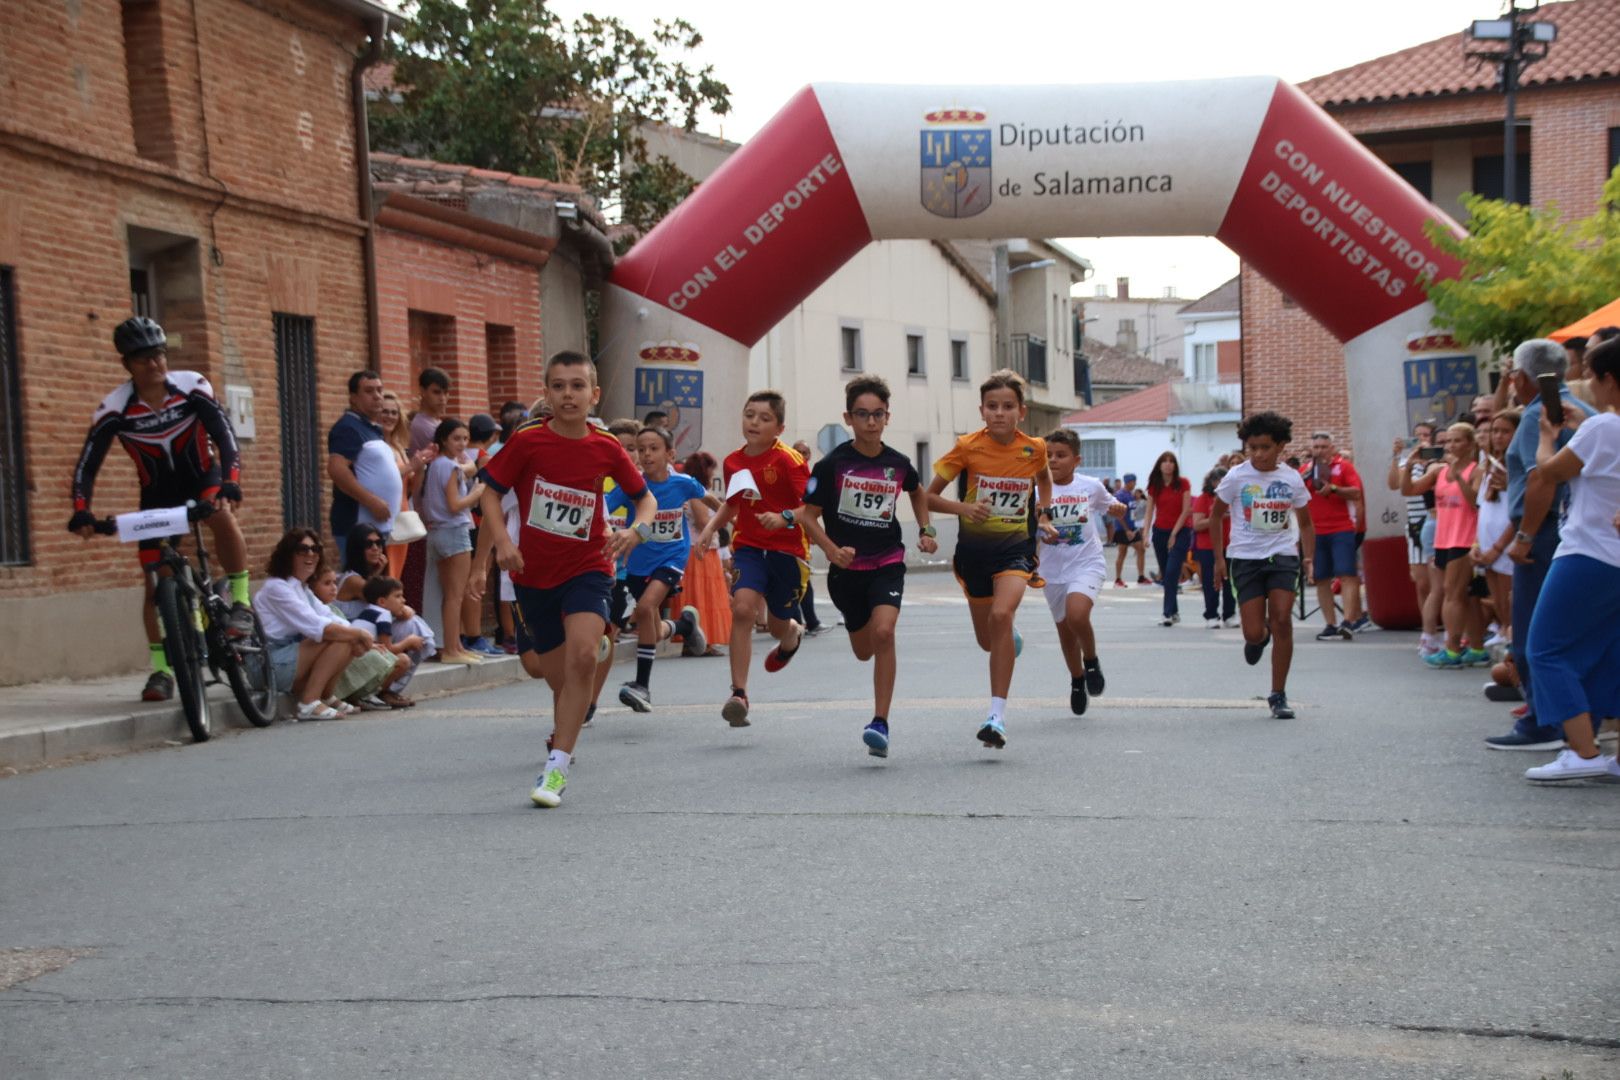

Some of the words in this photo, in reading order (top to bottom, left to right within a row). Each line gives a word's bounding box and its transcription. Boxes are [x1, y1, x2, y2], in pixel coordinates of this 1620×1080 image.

[999, 118, 1145, 151] Diputación
[998, 177, 1022, 197] de
[1033, 170, 1172, 196] Salamanca
[1274, 139, 1325, 187] CON
[1321, 179, 1440, 281] NUESTROS
[667, 265, 718, 311] CON
[713, 243, 748, 272] EL
[743, 153, 843, 245] DEPORTE
[1259, 170, 1406, 298] DEPORTISTAS
[844, 478, 896, 494] bedunia
[980, 479, 1029, 491] bedunia
[853, 492, 884, 510] 159
[989, 491, 1020, 508] 172
[544, 501, 582, 526] 170
[1050, 504, 1079, 518] 174
[1262, 510, 1286, 524] 185
[1381, 507, 1399, 524] de
[652, 521, 676, 535] 153
